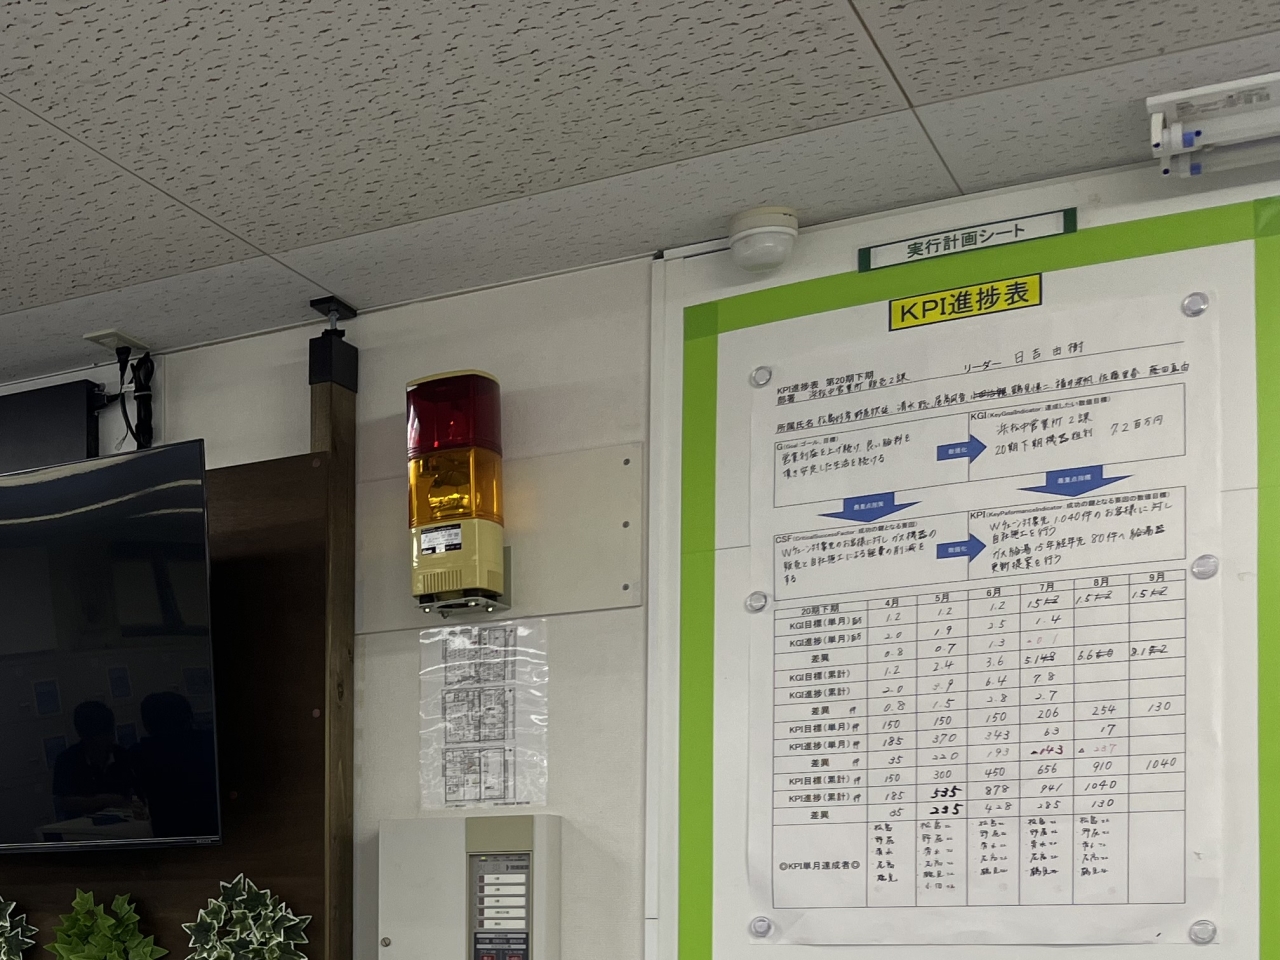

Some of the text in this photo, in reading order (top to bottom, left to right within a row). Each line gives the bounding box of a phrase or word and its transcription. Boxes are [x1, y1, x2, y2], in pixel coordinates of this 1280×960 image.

[906, 223, 1025, 259] 実行計画シート
[900, 281, 1030, 323] KPI進捗表
[964, 360, 1002, 373] リーダー
[776, 370, 874, 395] KPI進捗表 第20期下期
[776, 393, 796, 405] 部署
[776, 419, 814, 433] 所属氏名
[801, 572, 1165, 616] 20期下期 4月 5月 6月 7月 8月 9月
[811, 653, 830, 663] 差異
[811, 706, 830, 716] 差異
[882, 719, 901, 730] 150
[933, 715, 952, 726] 150
[986, 711, 1007, 723] 150
[1037, 707, 1059, 719] 206
[1092, 704, 1117, 716] 254
[1147, 701, 1172, 712] 130
[932, 733, 957, 745] 370
[810, 758, 830, 767] 差異
[884, 773, 901, 783] 150
[985, 767, 1006, 778] 450
[1037, 763, 1058, 775] 656
[1092, 760, 1113, 773] 910
[1145, 757, 1177, 771] 1040
[985, 786, 1010, 796] 878
[1084, 780, 1117, 791] 1040
[810, 810, 830, 820] 差異
